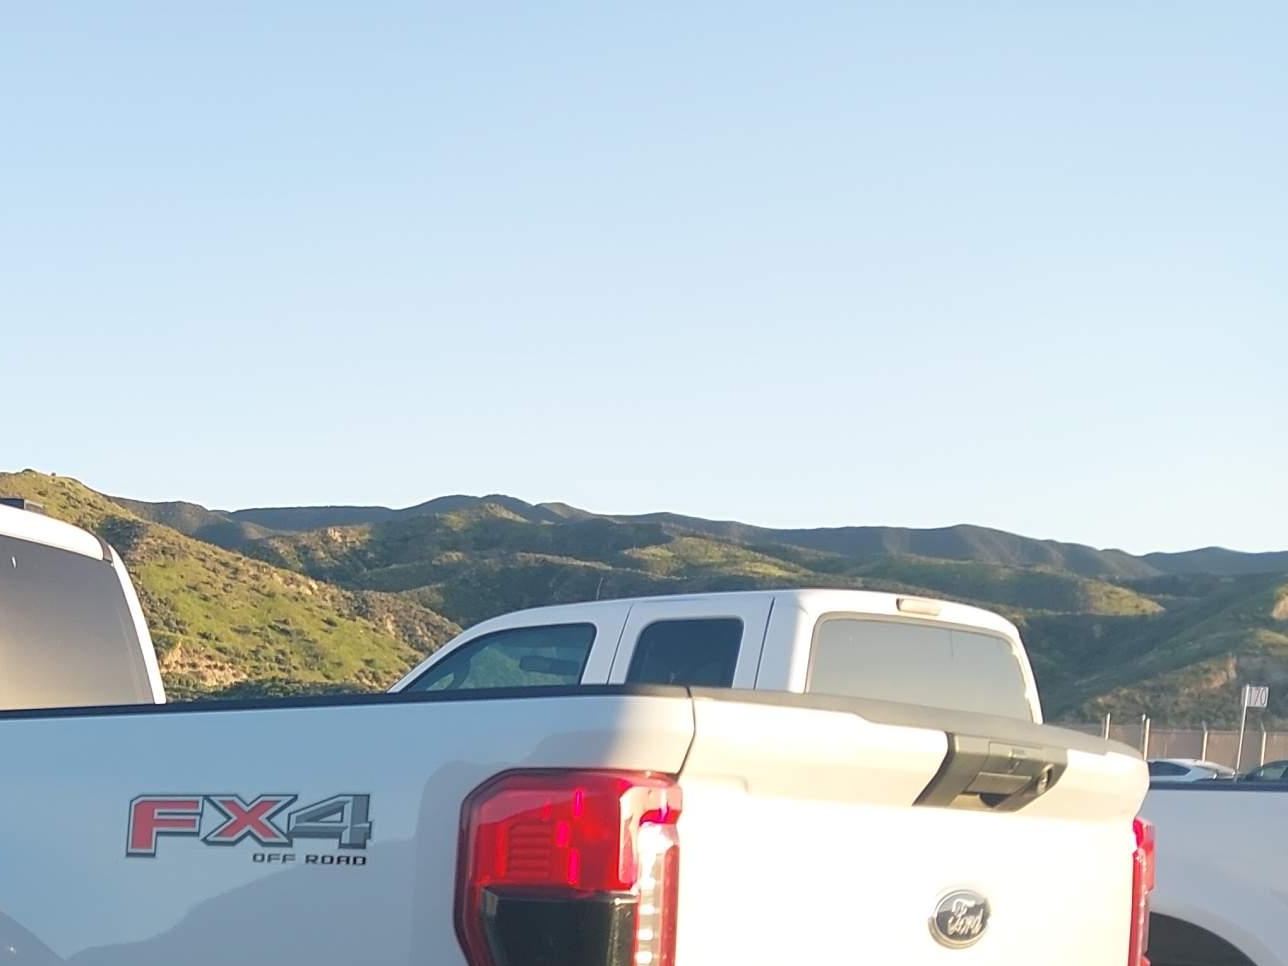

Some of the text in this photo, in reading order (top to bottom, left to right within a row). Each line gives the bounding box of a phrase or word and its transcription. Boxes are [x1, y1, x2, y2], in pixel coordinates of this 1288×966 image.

[125, 793, 372, 858] FX4
[252, 852, 368, 867] OFF ROAD
[947, 898, 985, 936] Ford
